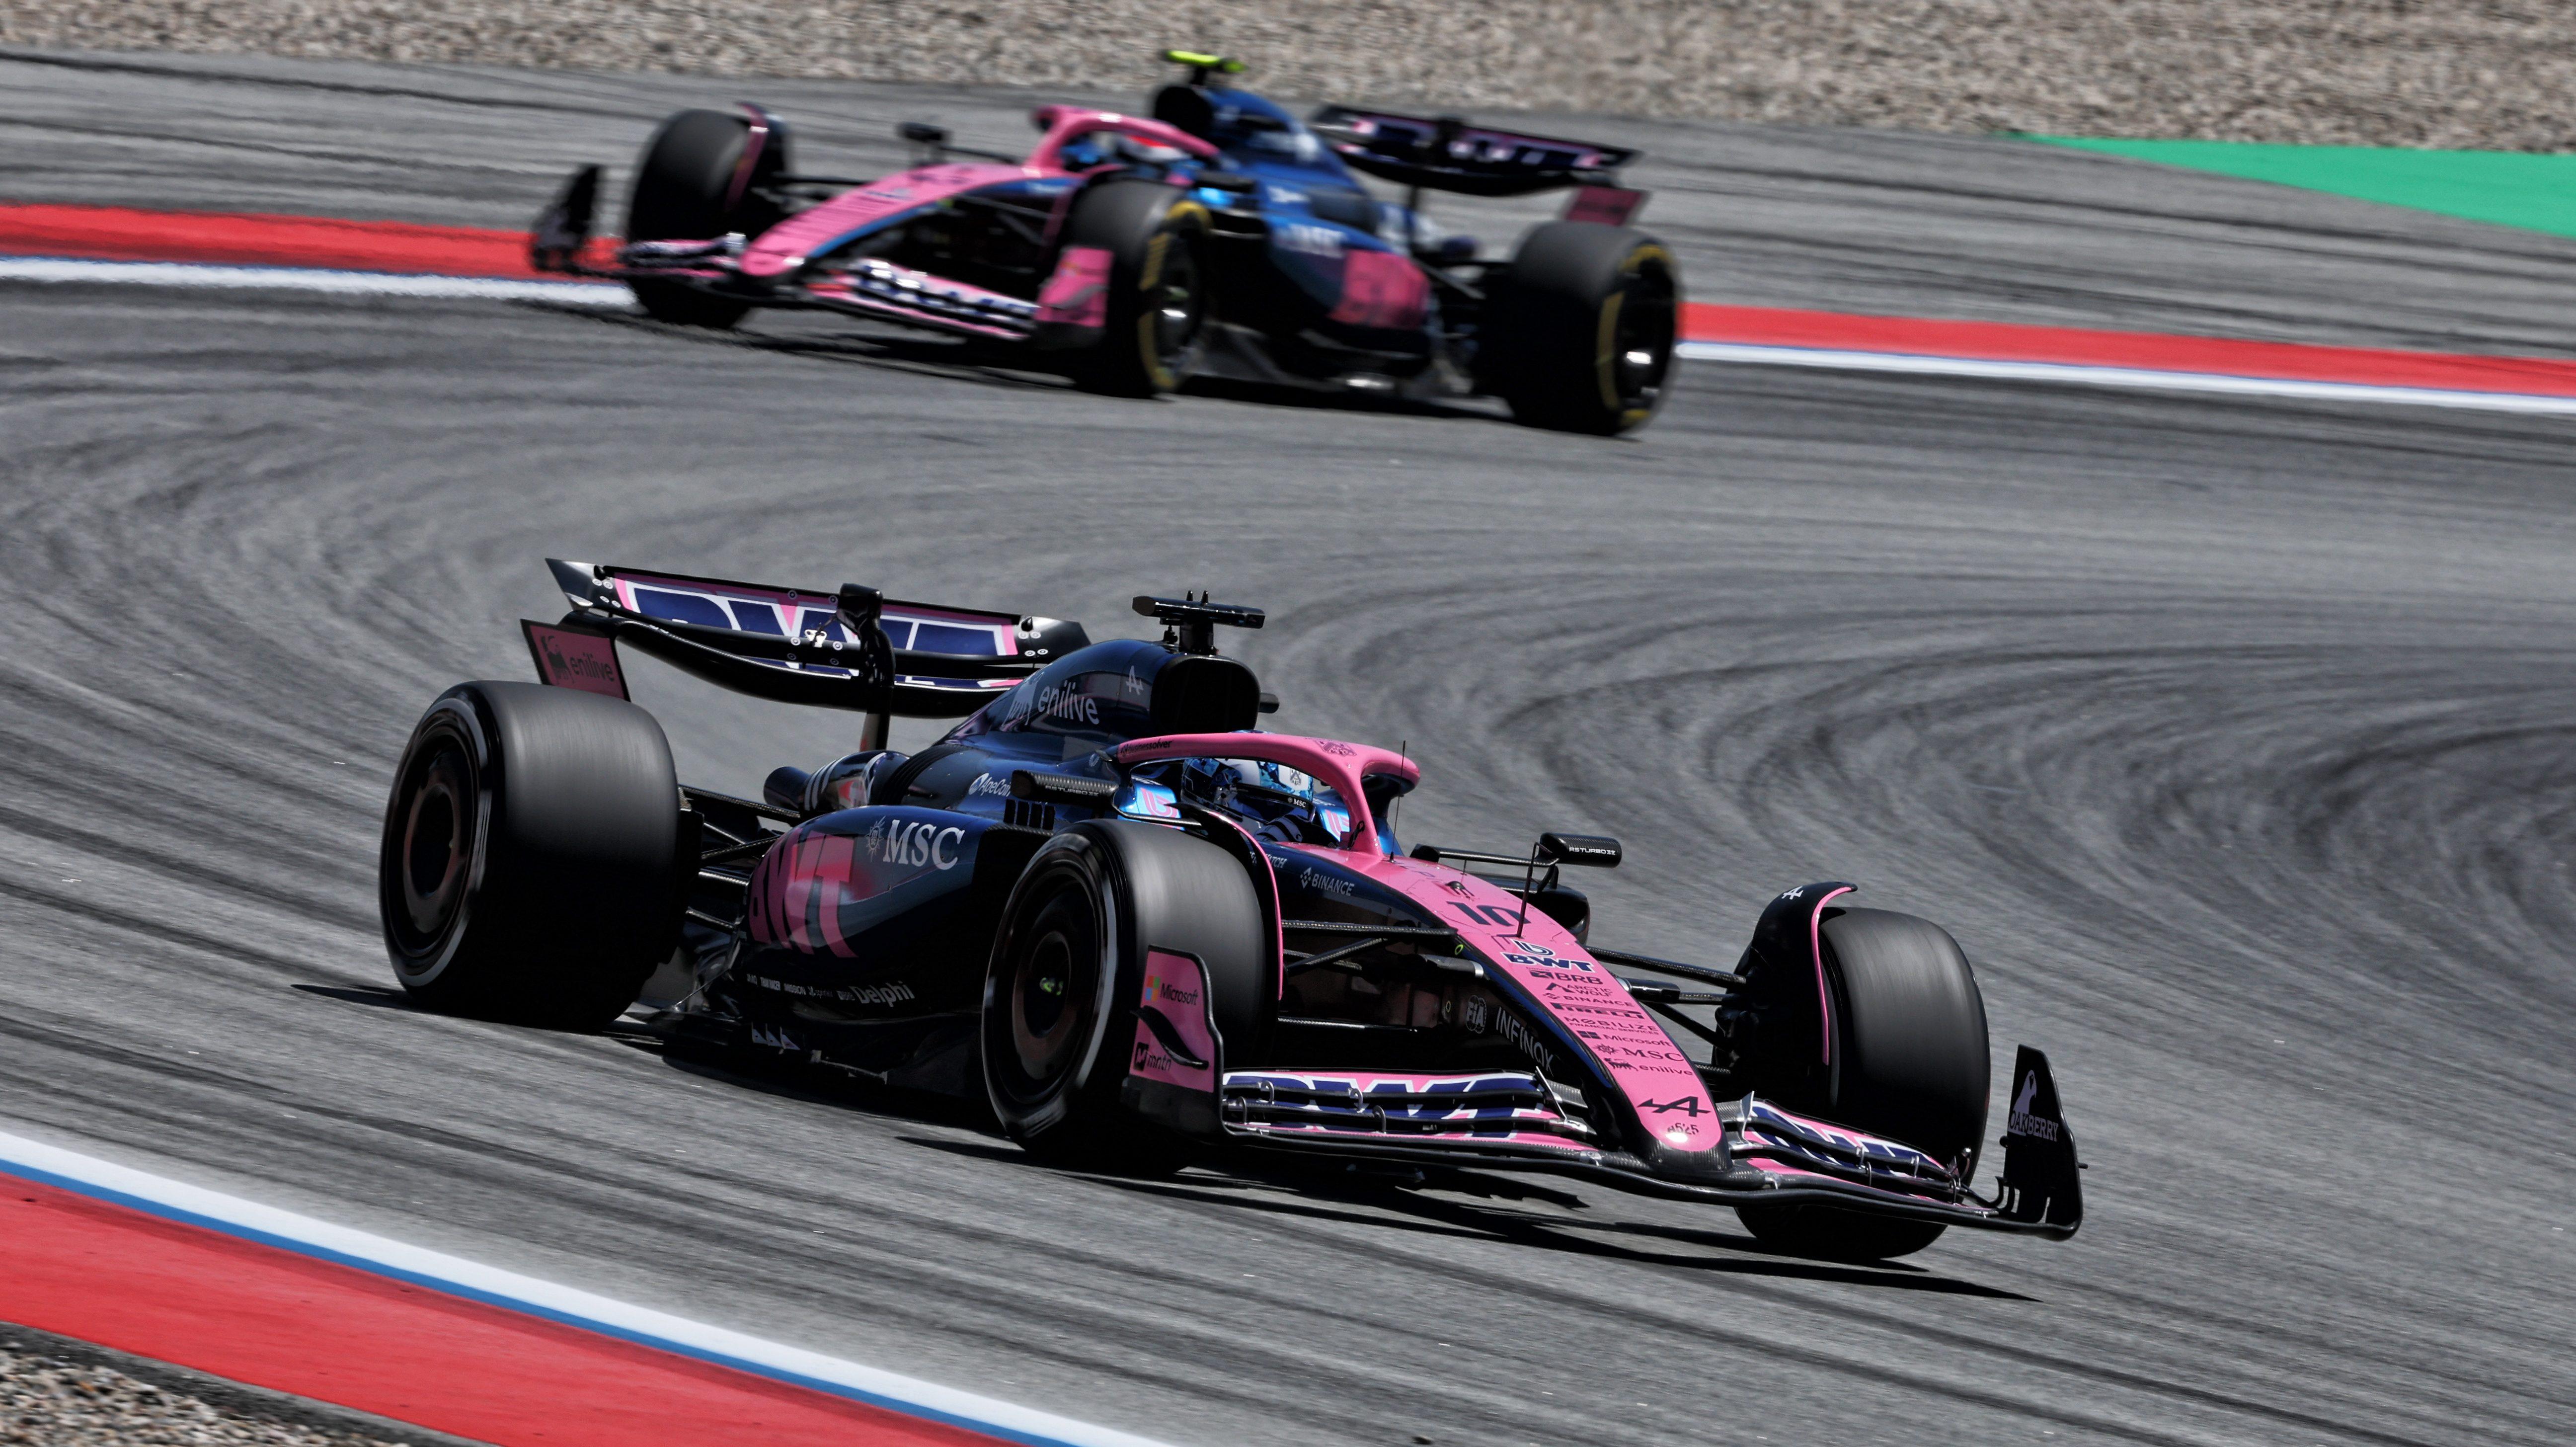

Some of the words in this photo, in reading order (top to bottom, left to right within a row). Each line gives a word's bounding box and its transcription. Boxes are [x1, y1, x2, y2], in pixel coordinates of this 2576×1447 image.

[570, 652, 614, 681] enilive
[1038, 680, 1099, 724] enilive
[1293, 798, 1306, 807] MSC
[883, 819, 965, 870] MSC
[1312, 874, 1355, 896] BINANCE
[1501, 952, 1595, 972] BWT
[1555, 972, 1603, 984] BRB
[849, 980, 915, 1007] Delphi
[1160, 983, 1198, 1005] Microsoft
[1567, 984, 1613, 993] ARCTIC
[1550, 1002, 1645, 1019] PIRELLI
[1564, 996, 1634, 1007] BINANCE
[1496, 1006, 1555, 1078] INFINOX
[1603, 1034, 1673, 1046] Microsoft
[1148, 1054, 1171, 1071] mntn
[1620, 1047, 1684, 1061] MSC
[1639, 1064, 1693, 1075] enilive
[2010, 1110, 2058, 1142] OAKBERRY
